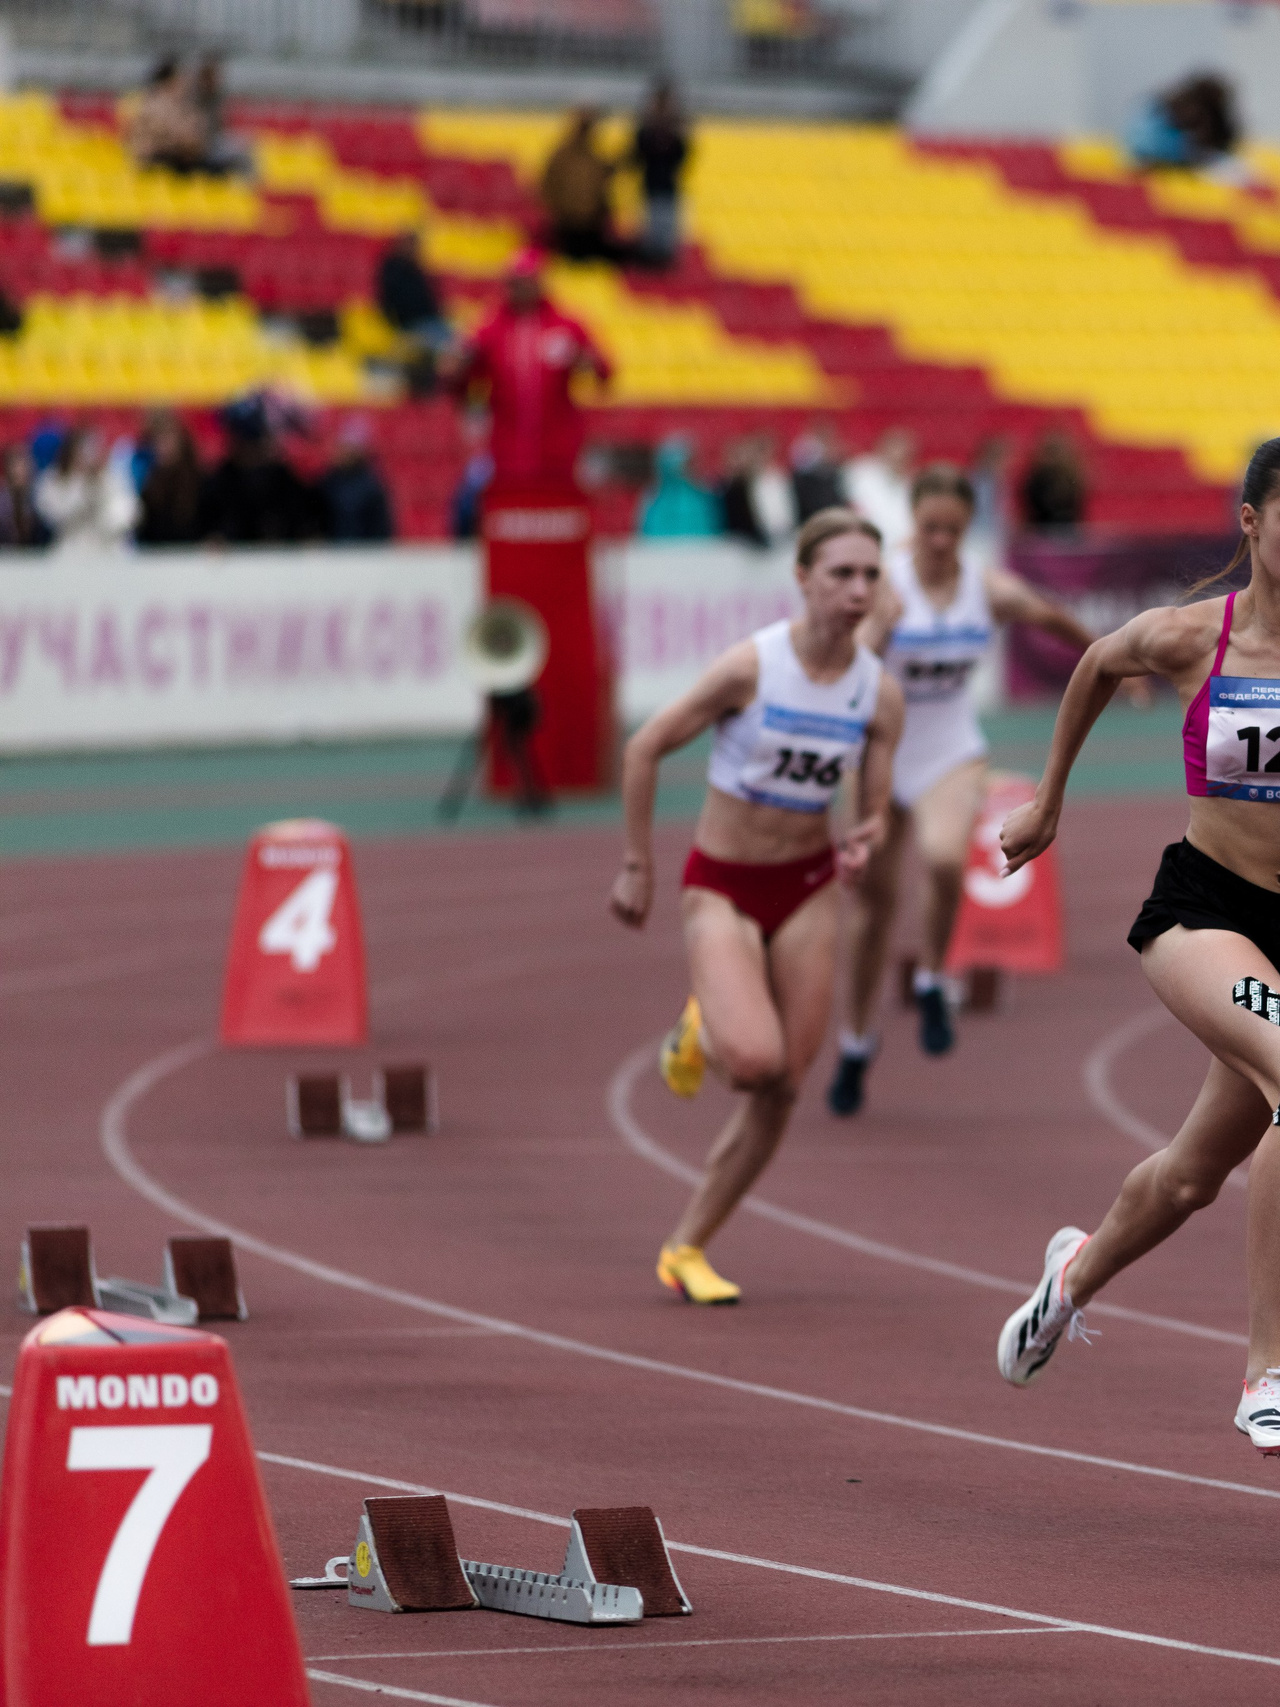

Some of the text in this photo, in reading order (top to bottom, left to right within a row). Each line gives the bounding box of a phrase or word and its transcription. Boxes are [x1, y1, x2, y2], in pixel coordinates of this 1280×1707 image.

[774, 747, 843, 788] 136
[259, 866, 339, 972] 4
[56, 1373, 219, 1410] MONDO
[66, 1424, 213, 1645] 7
